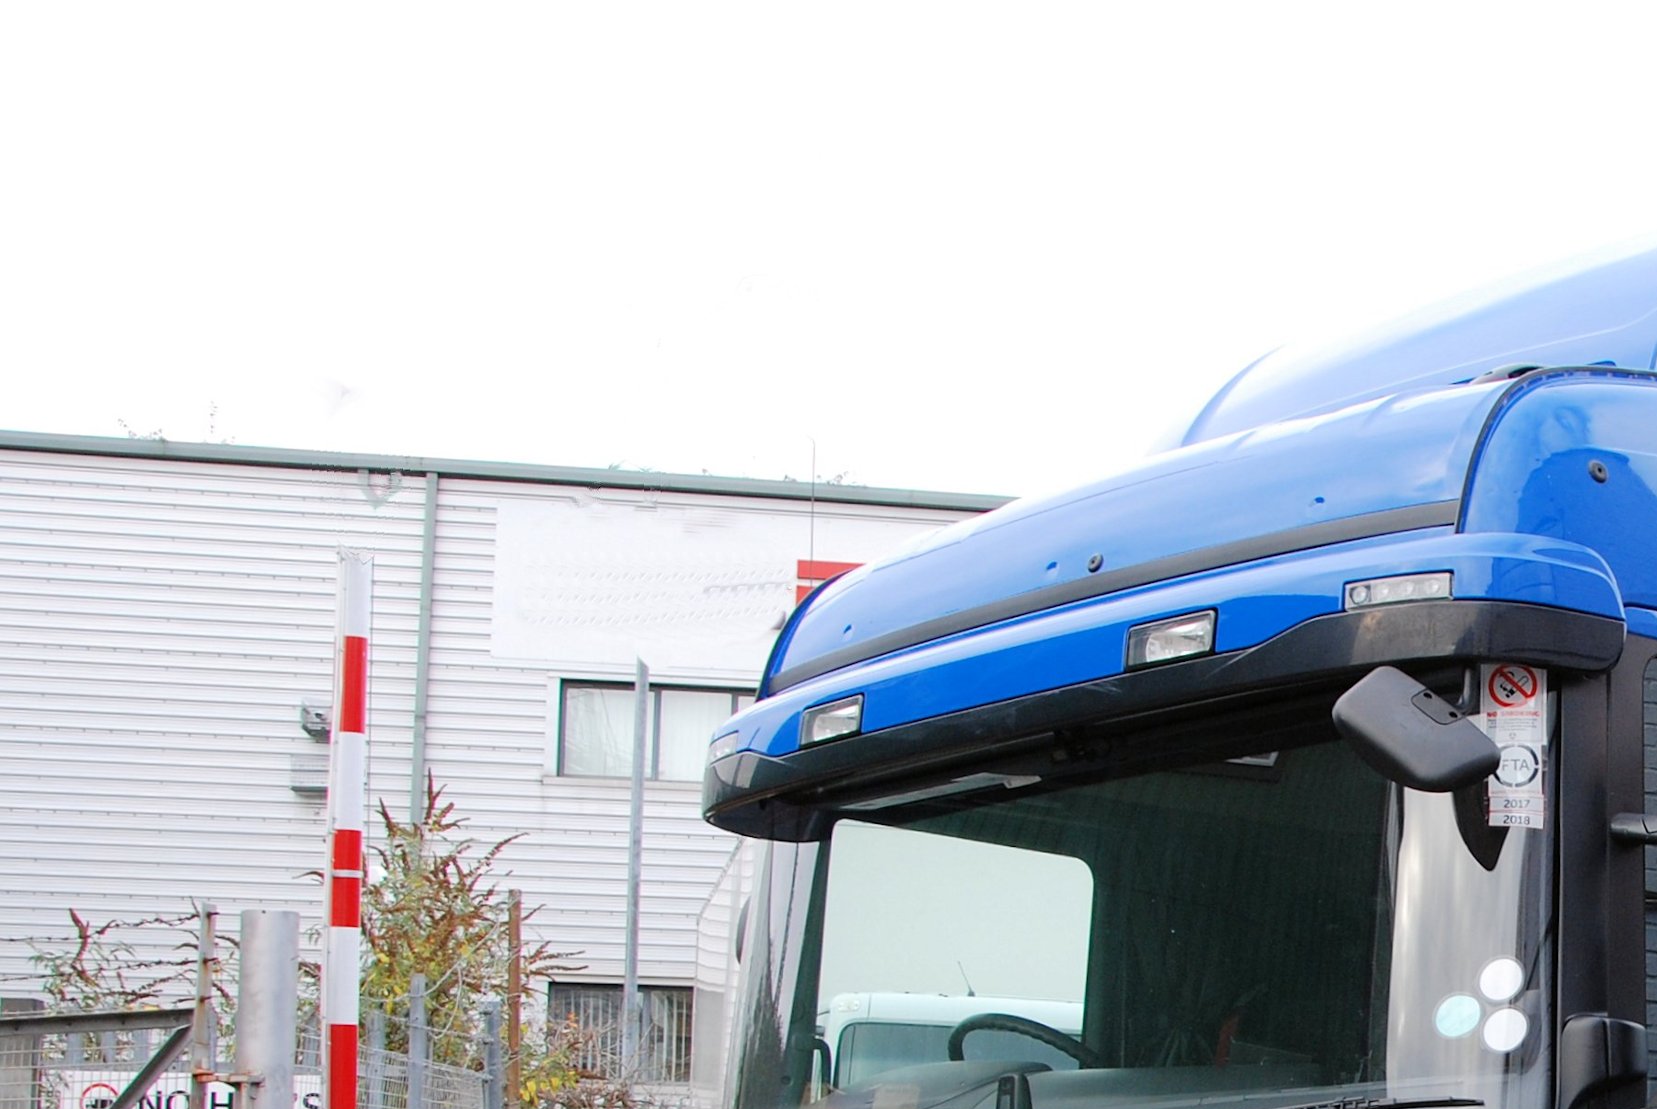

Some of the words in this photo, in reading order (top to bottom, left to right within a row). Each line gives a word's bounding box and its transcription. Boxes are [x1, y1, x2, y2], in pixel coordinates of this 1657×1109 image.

[1501, 758, 1530, 772] FTA
[1503, 799, 1530, 809] 2017
[1502, 814, 1531, 825] 2018
